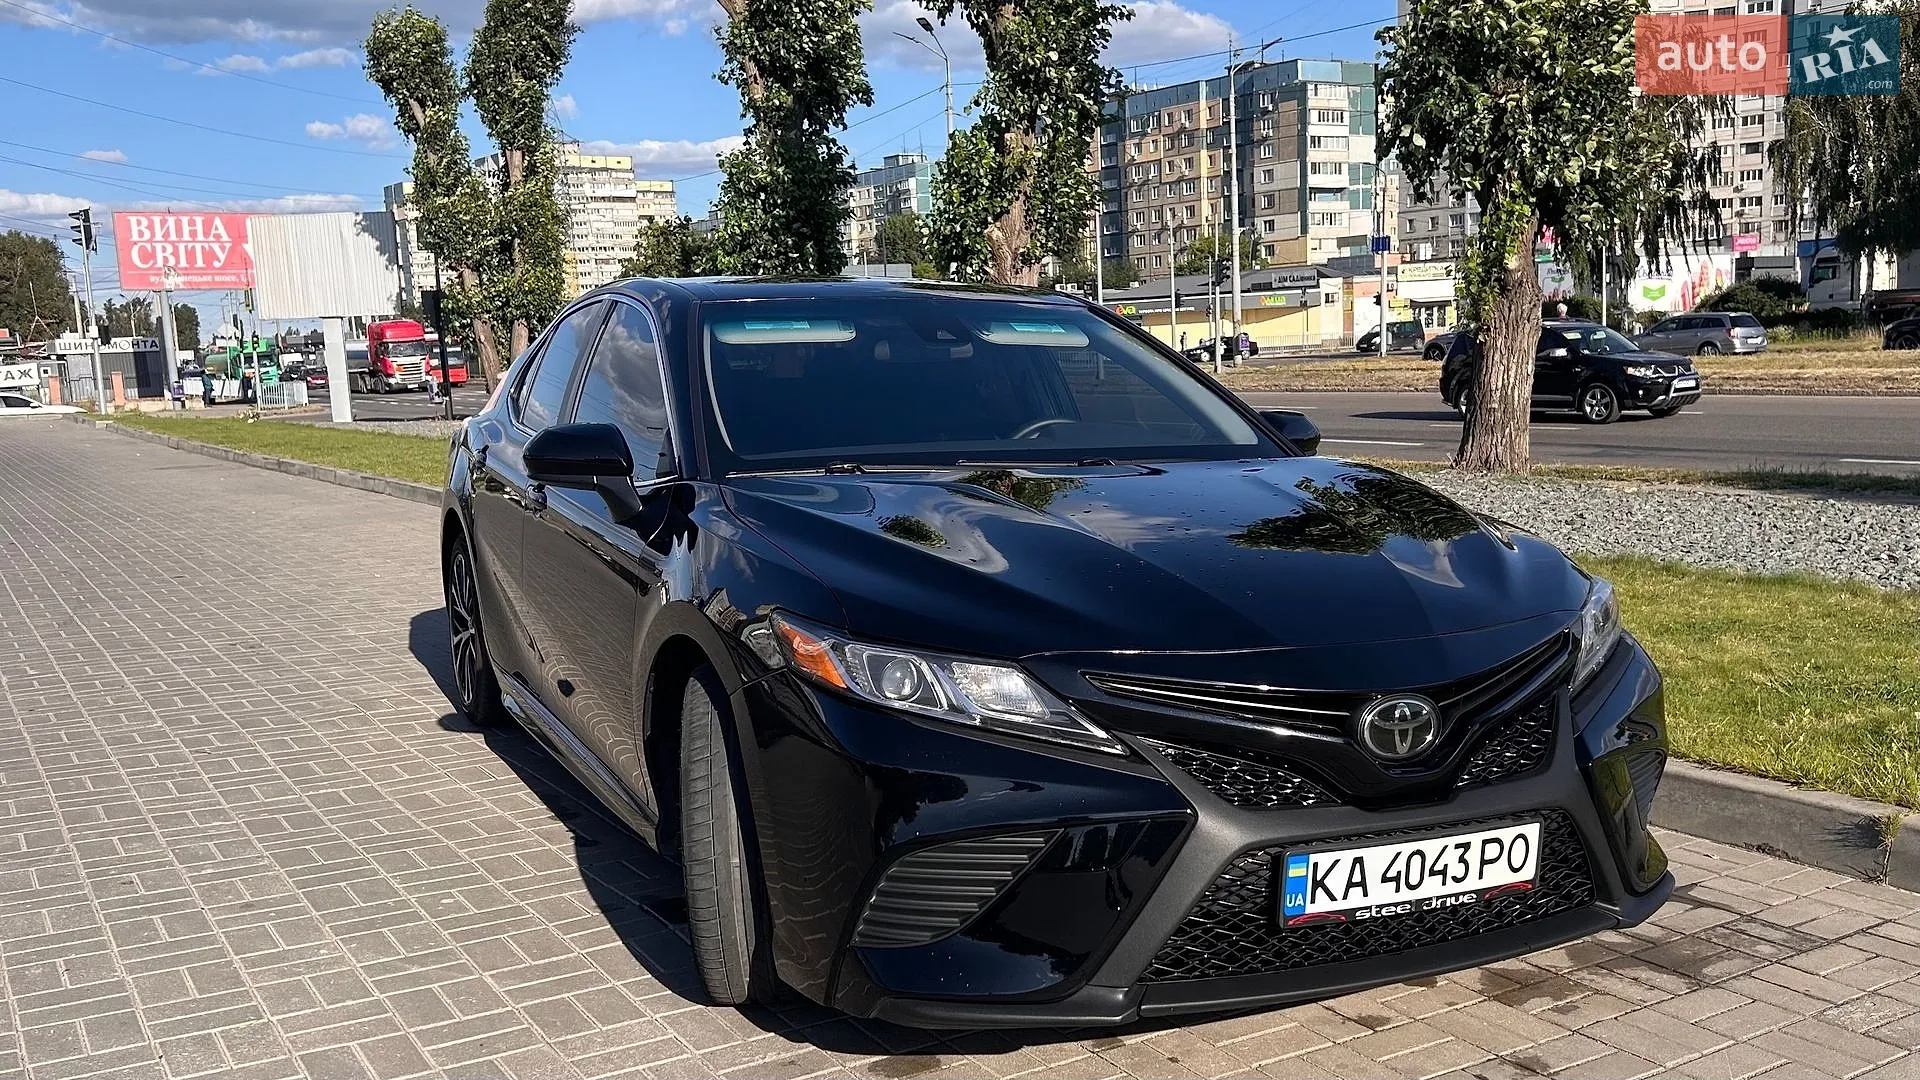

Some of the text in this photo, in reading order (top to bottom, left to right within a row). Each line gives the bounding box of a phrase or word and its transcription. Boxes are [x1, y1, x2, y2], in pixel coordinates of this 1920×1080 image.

[128, 216, 232, 242] ВИНА
[130, 243, 232, 268] СВІТУ
[0, 368, 34, 381] АЖ
[1310, 833, 1530, 904] KA 4043 PO
[1286, 893, 1305, 909] UA
[1421, 893, 1478, 911] drive
